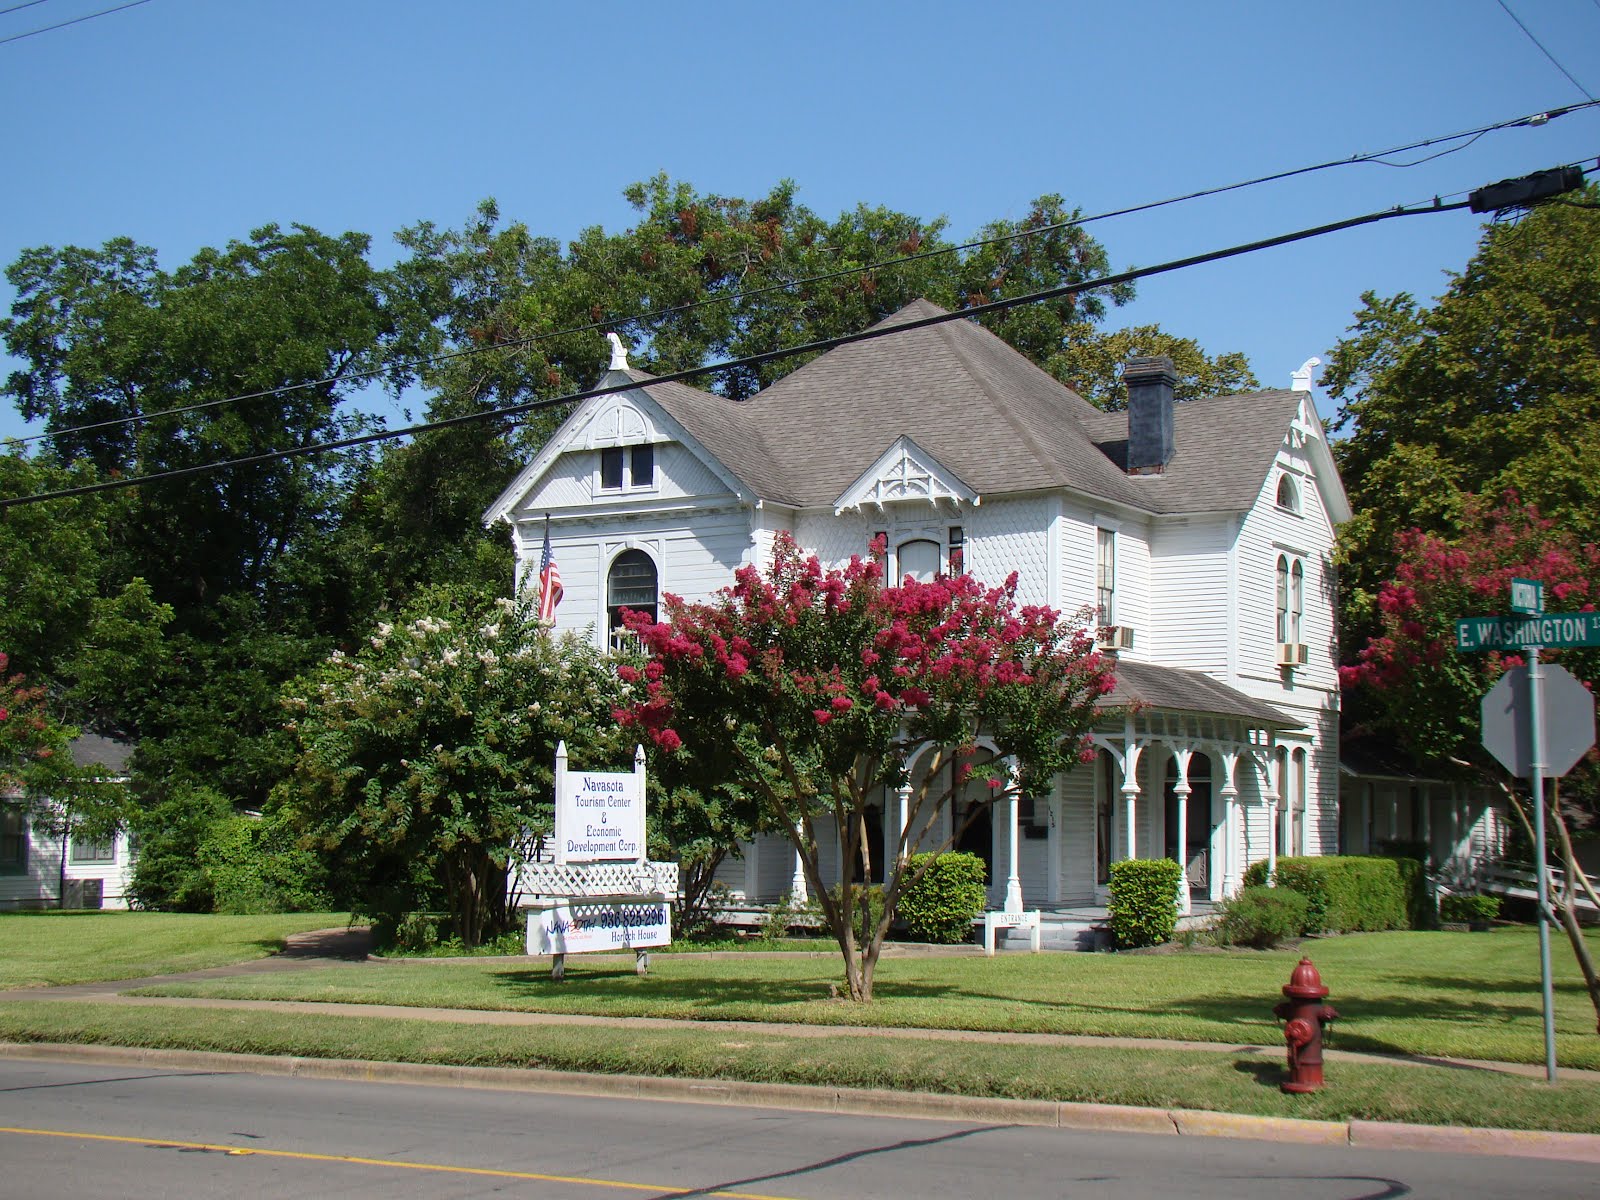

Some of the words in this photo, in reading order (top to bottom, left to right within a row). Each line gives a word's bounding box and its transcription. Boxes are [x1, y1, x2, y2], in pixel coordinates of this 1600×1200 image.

[1460, 624, 1474, 647] E.
[1477, 617, 1587, 646] WASHINGTON
[582, 777, 624, 792] Navasota
[575, 795, 606, 808] Tourism
[607, 795, 632, 808] Center
[601, 811, 607, 824] &
[586, 824, 622, 837] Economic
[567, 839, 616, 854] Development
[618, 839, 638, 854] Corp.
[600, 908, 667, 930] 936-825-2961
[1000, 914, 1028, 923] ENTRANCE
[611, 929, 636, 943] Horlock
[637, 929, 658, 941] House
